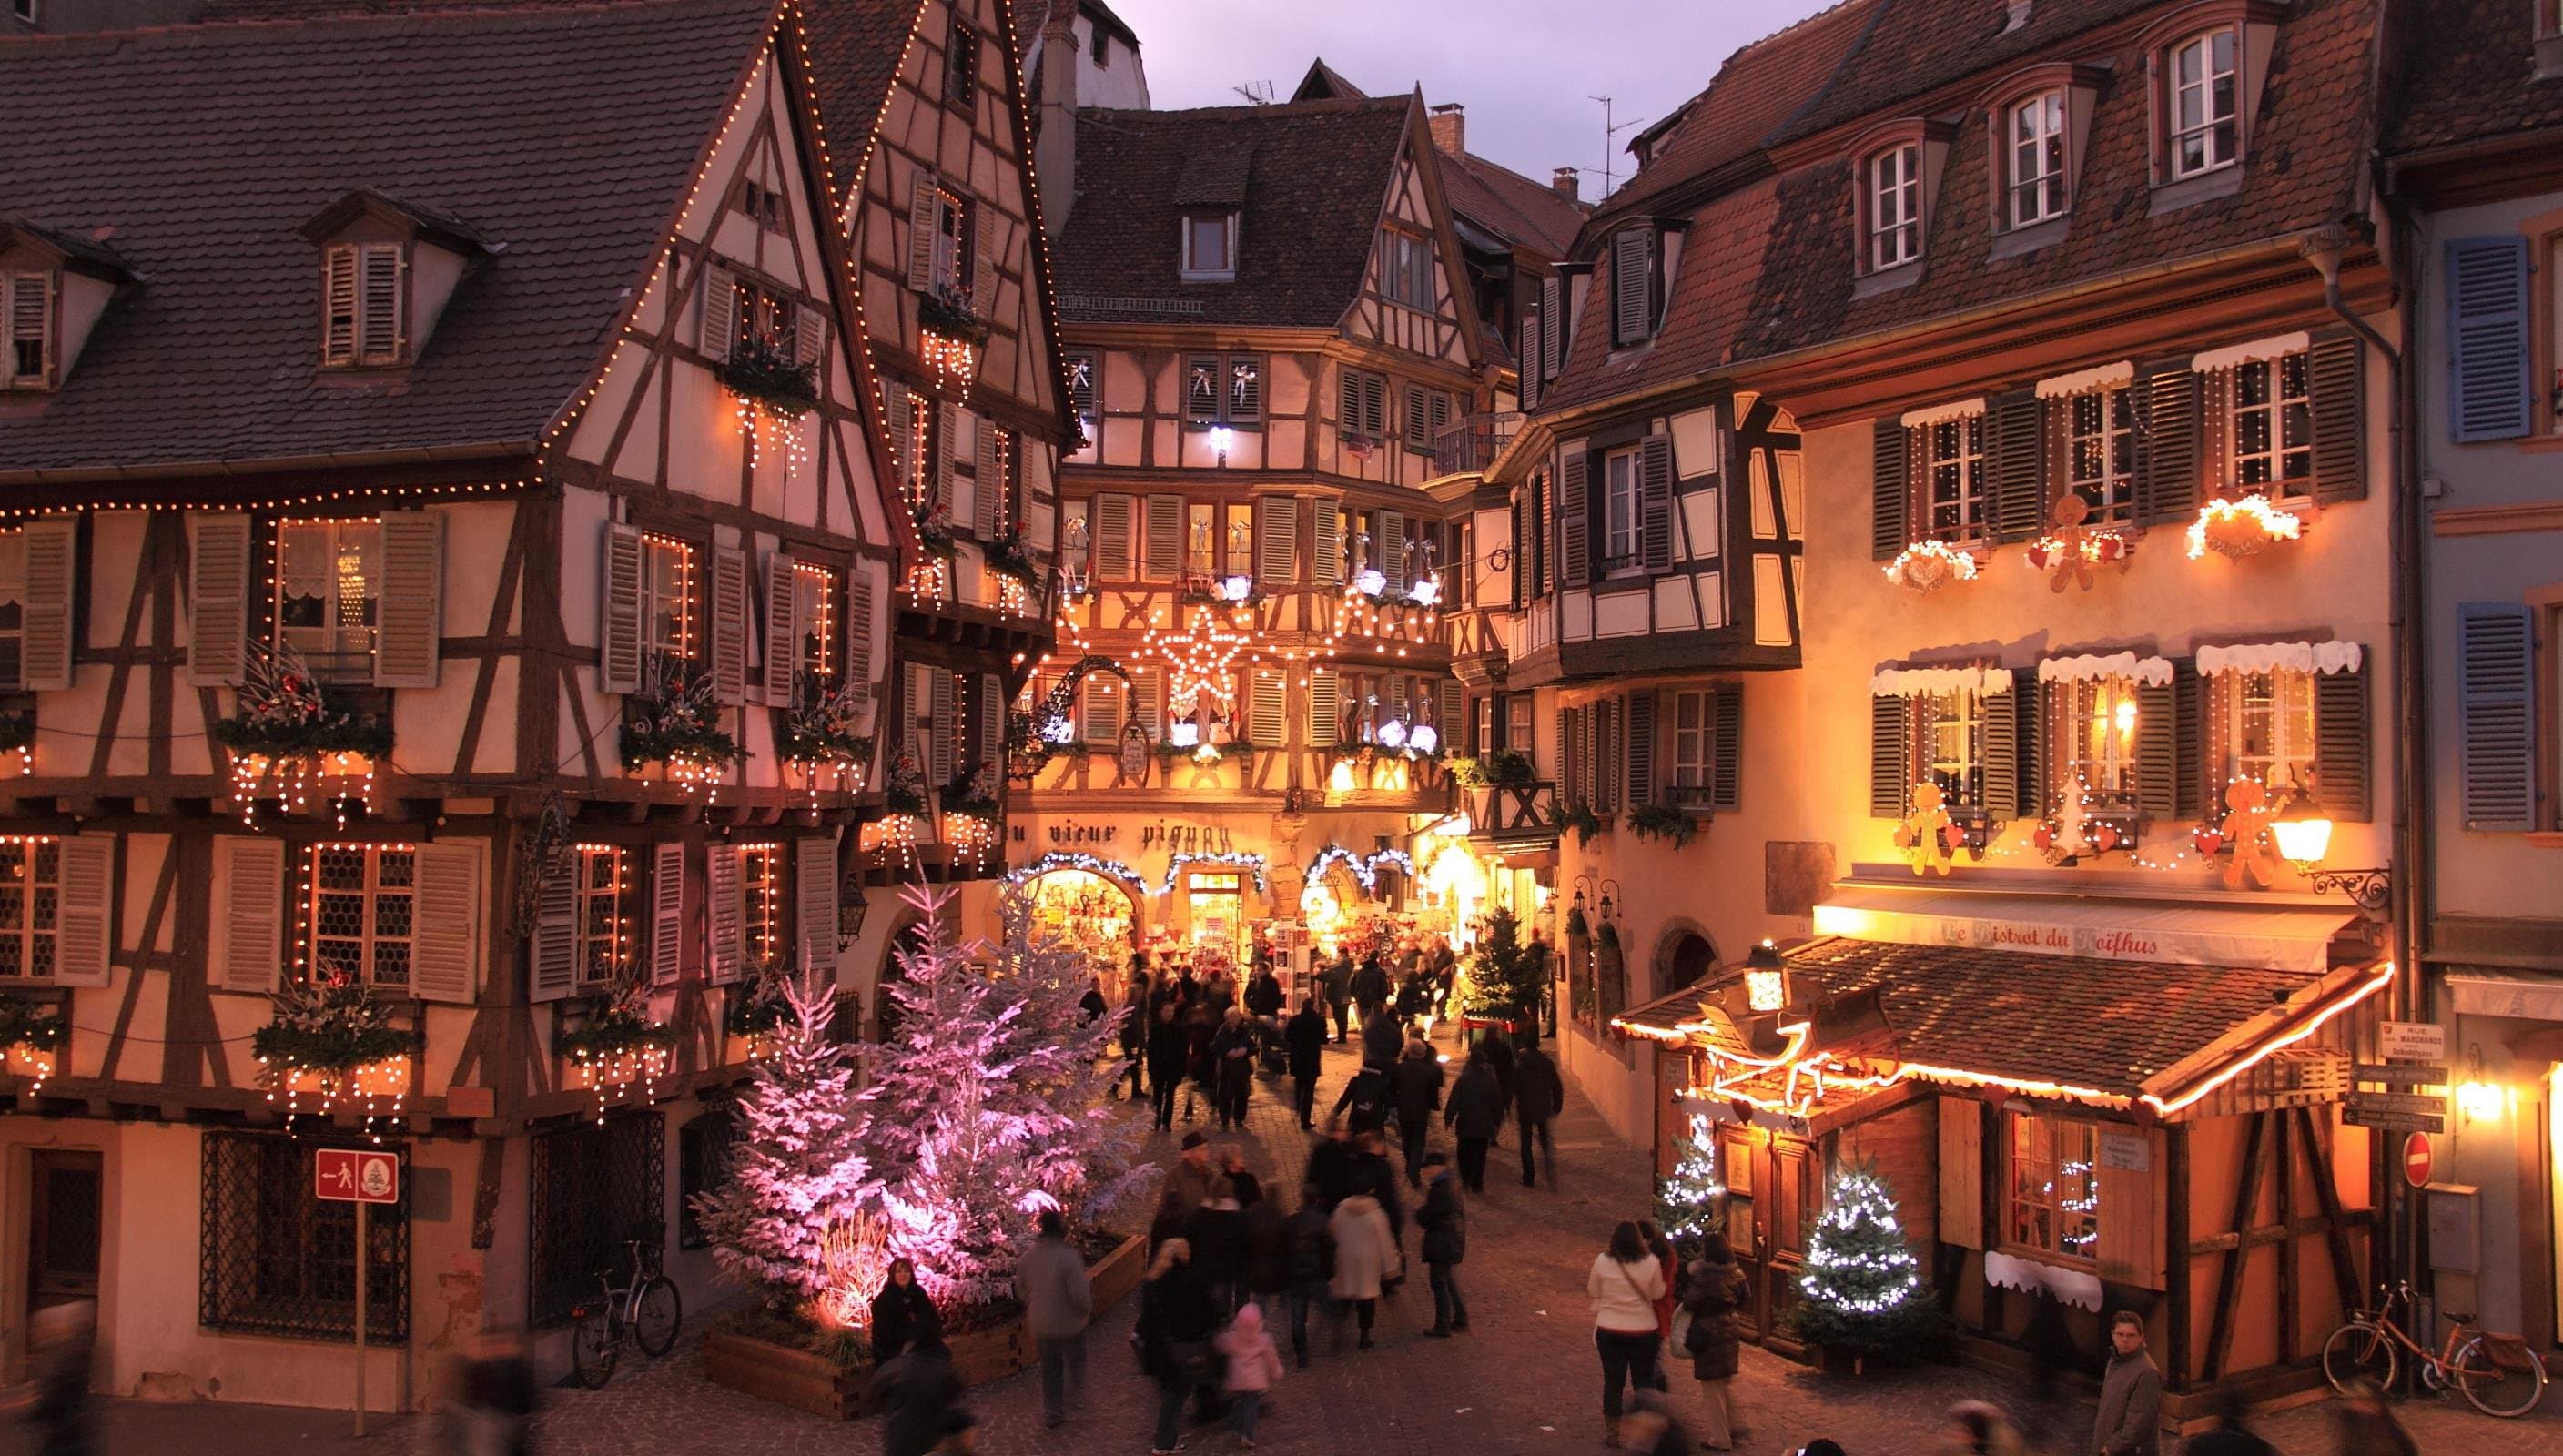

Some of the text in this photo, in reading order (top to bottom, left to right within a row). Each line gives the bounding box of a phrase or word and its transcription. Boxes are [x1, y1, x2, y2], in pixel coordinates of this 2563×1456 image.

[1974, 925, 2041, 946] Bistrot
[2046, 927, 2070, 948] du
[2407, 1026, 2427, 1035] RUE
